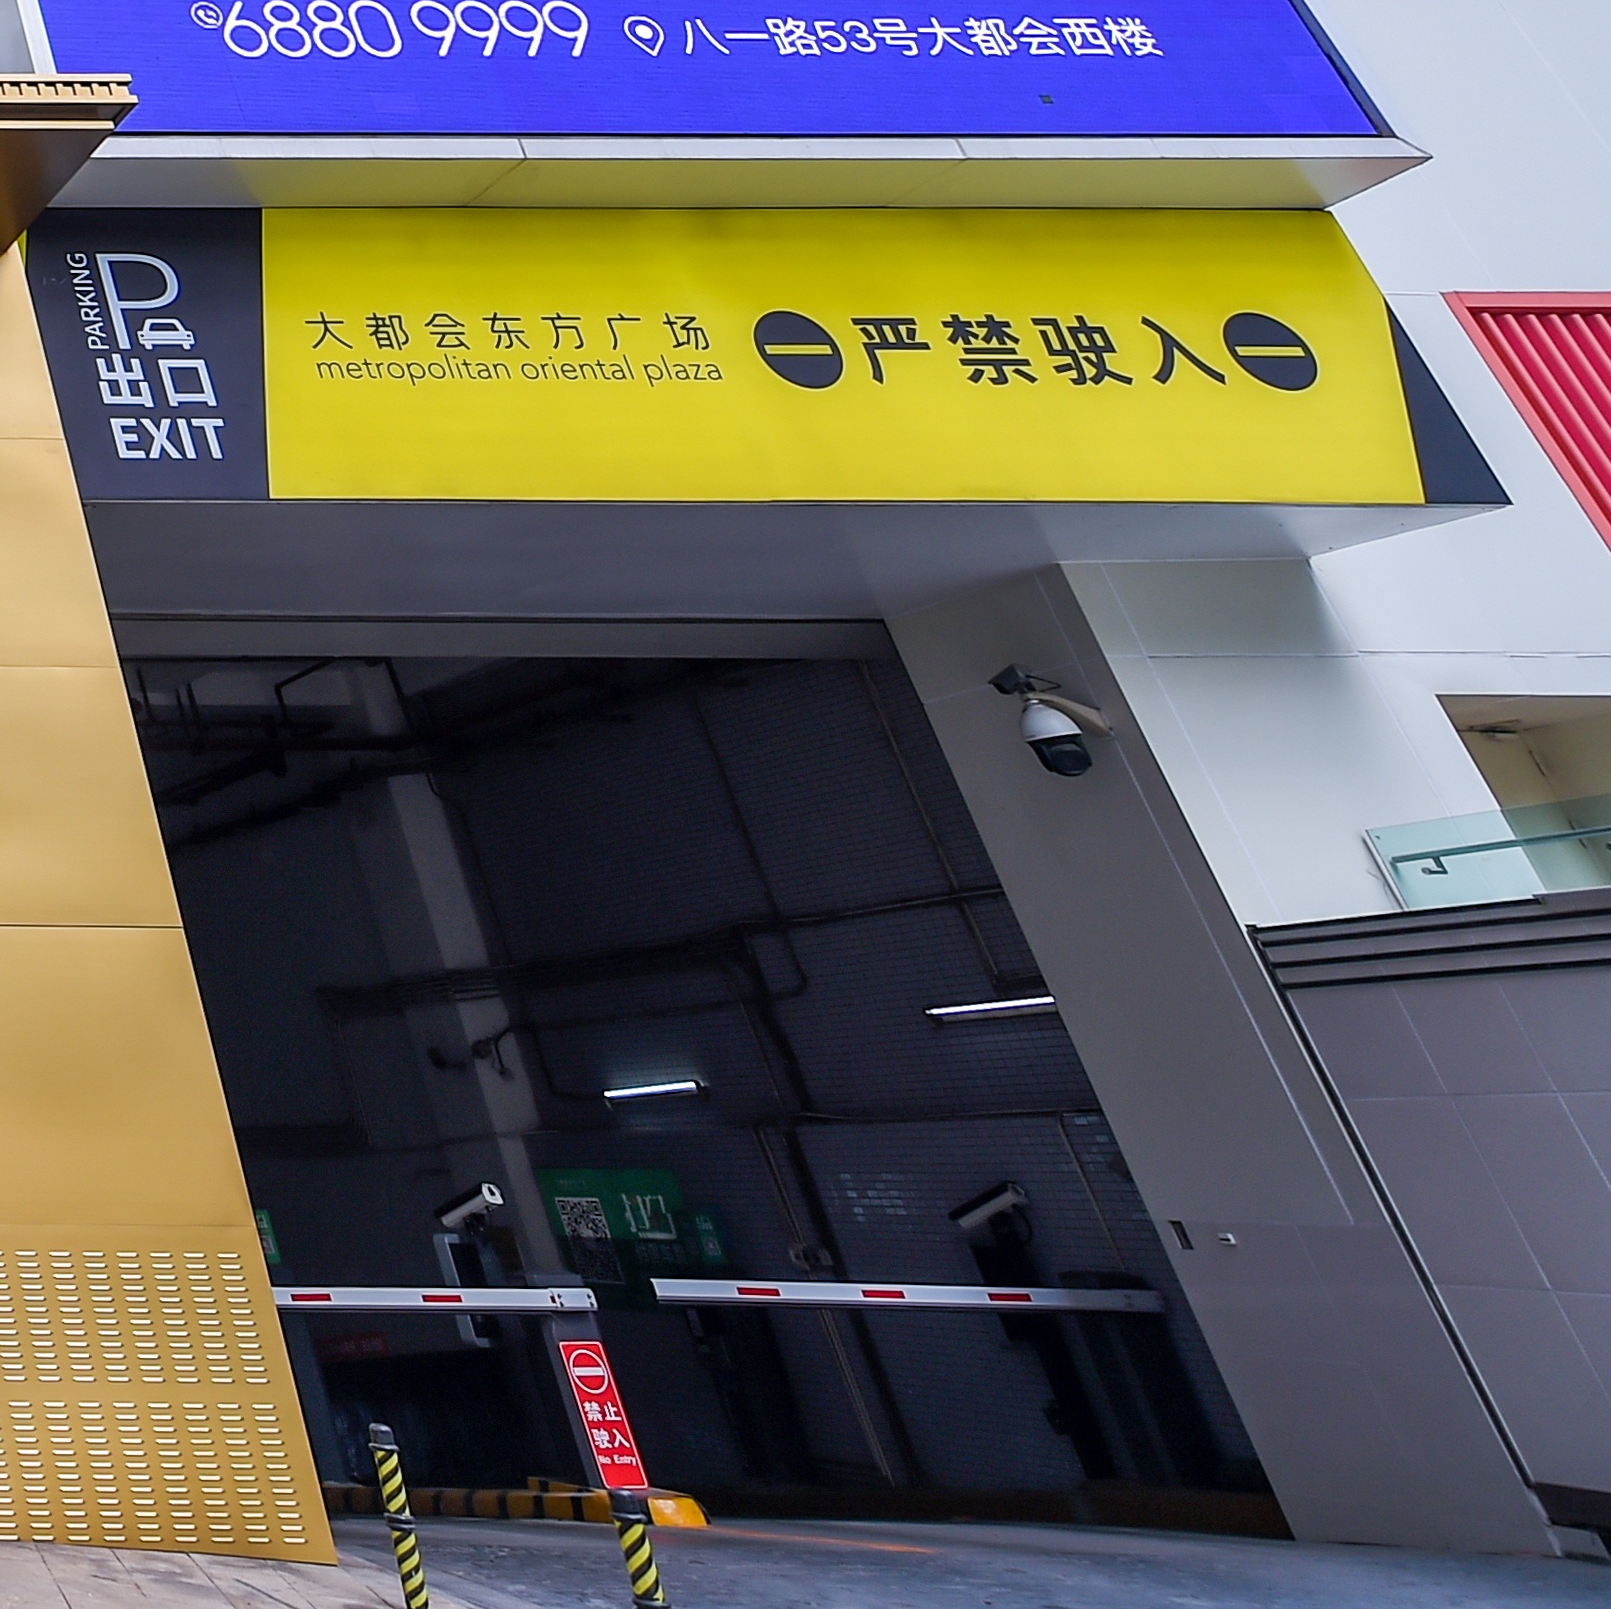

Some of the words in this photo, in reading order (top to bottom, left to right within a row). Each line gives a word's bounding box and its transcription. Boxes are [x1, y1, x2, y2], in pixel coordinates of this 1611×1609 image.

[682, 14, 1165, 60] 八一路53号大都会西楼
[66, 253, 110, 350] PARKING
[304, 311, 711, 351] 大都会东方广场
[850, 312, 1228, 387] 严禁驶入
[95, 353, 218, 408] 出口
[315, 354, 512, 386] metropolitan
[520, 355, 636, 381] oriental
[642, 354, 724, 388] plaza
[109, 418, 225, 459] EXIT
[583, 1401, 622, 1422] 禁止
[591, 1427, 631, 1449] 驶入
